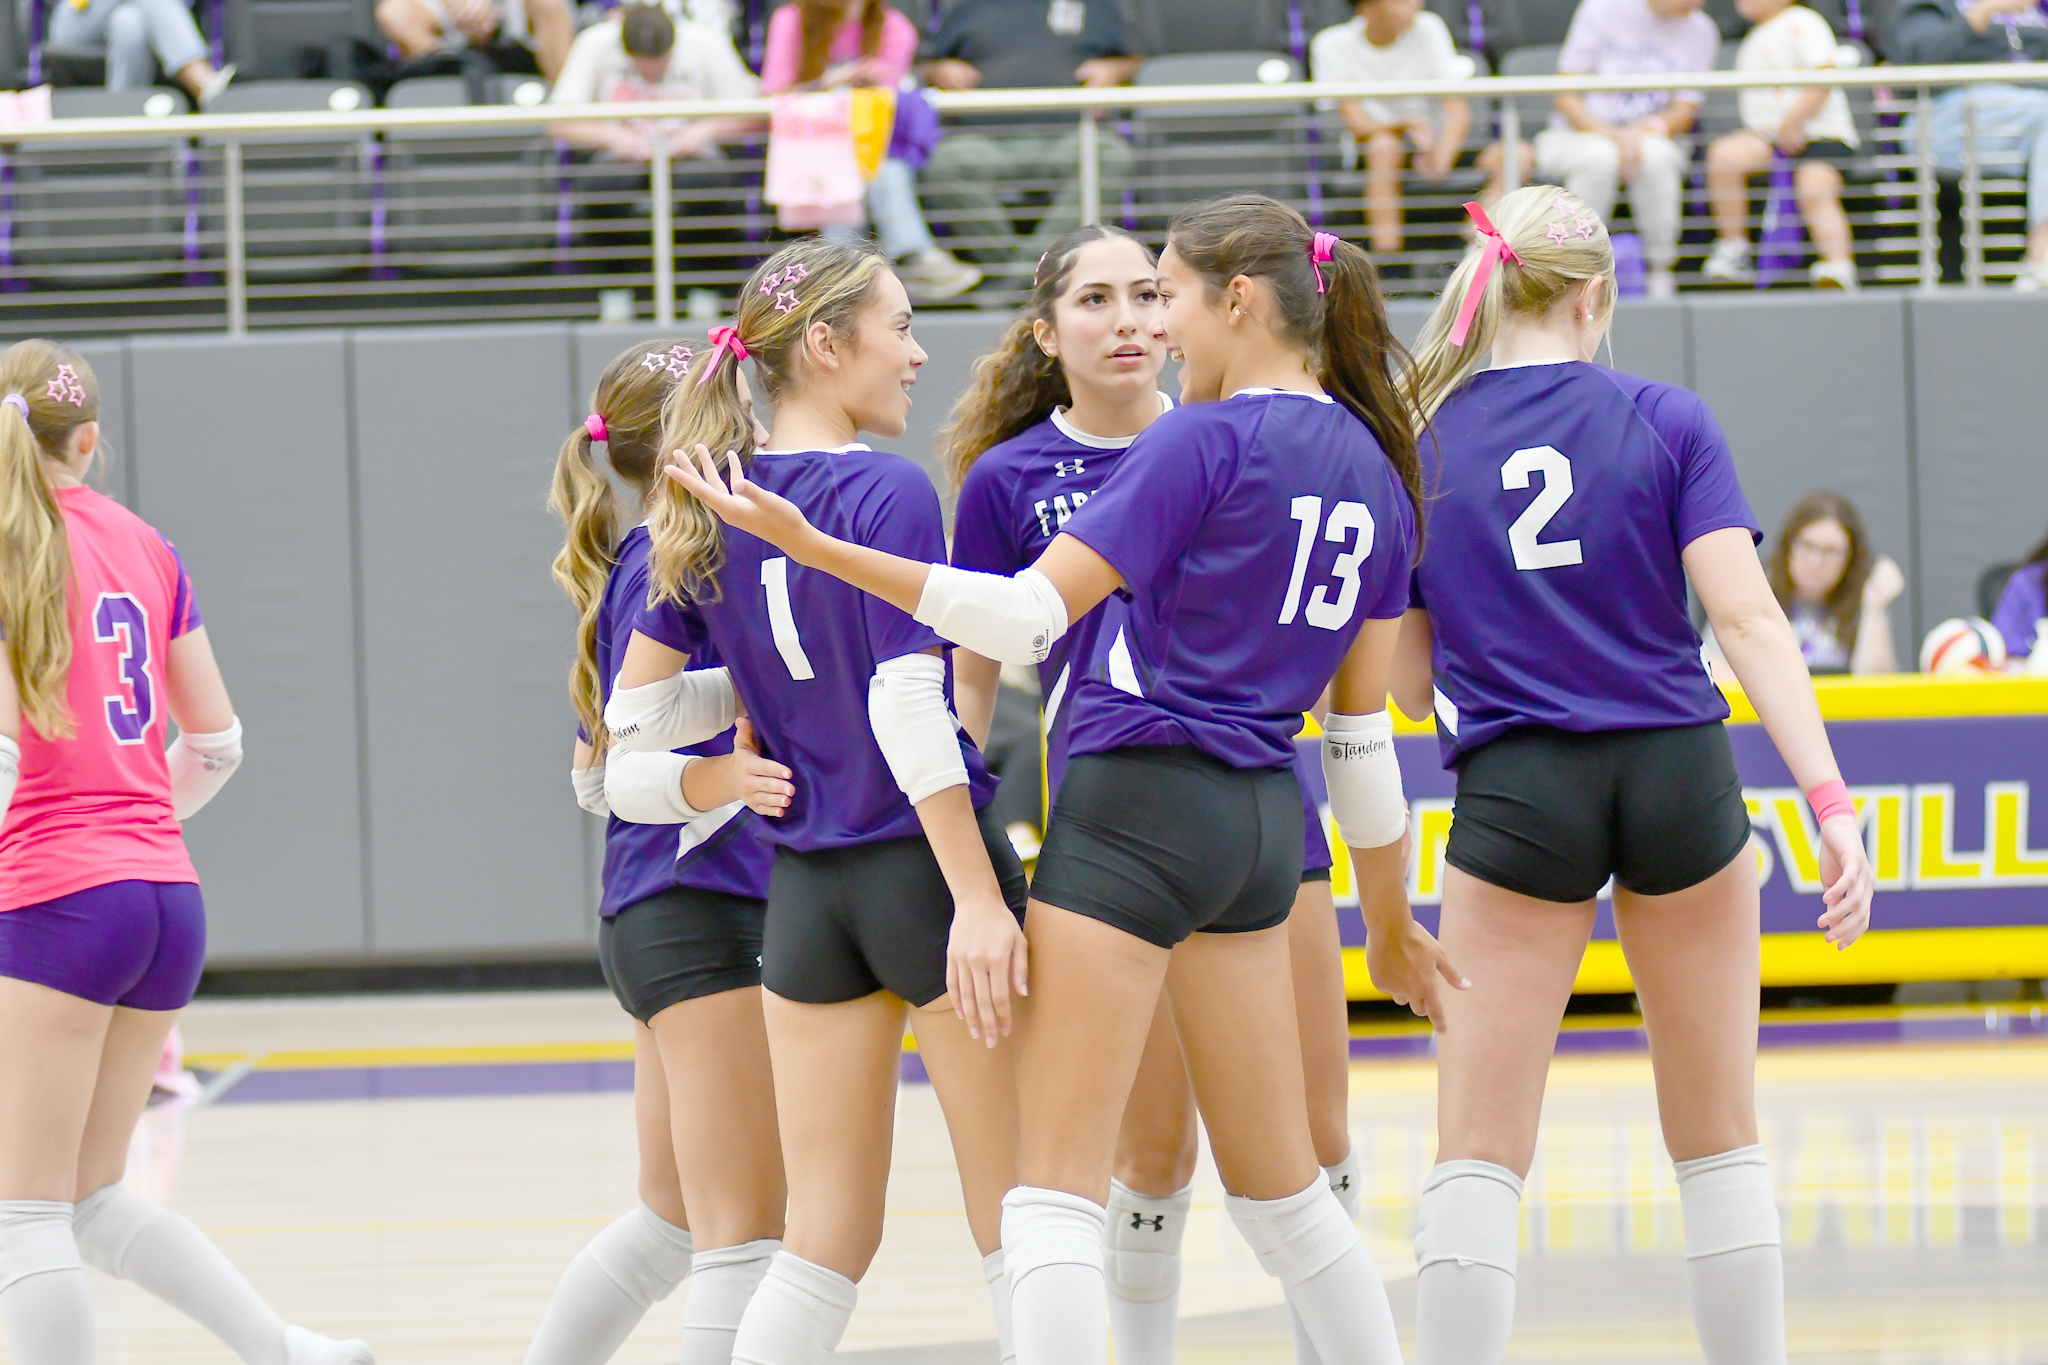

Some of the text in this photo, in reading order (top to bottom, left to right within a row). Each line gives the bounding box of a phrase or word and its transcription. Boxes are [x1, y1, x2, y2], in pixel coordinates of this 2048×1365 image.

[1033, 489, 1099, 537] FA
[1278, 495, 1375, 631] 13
[1501, 445, 1583, 570] 2
[92, 592, 156, 745] 3
[761, 556, 816, 680] 1
[1329, 739, 1386, 761] Tandem
